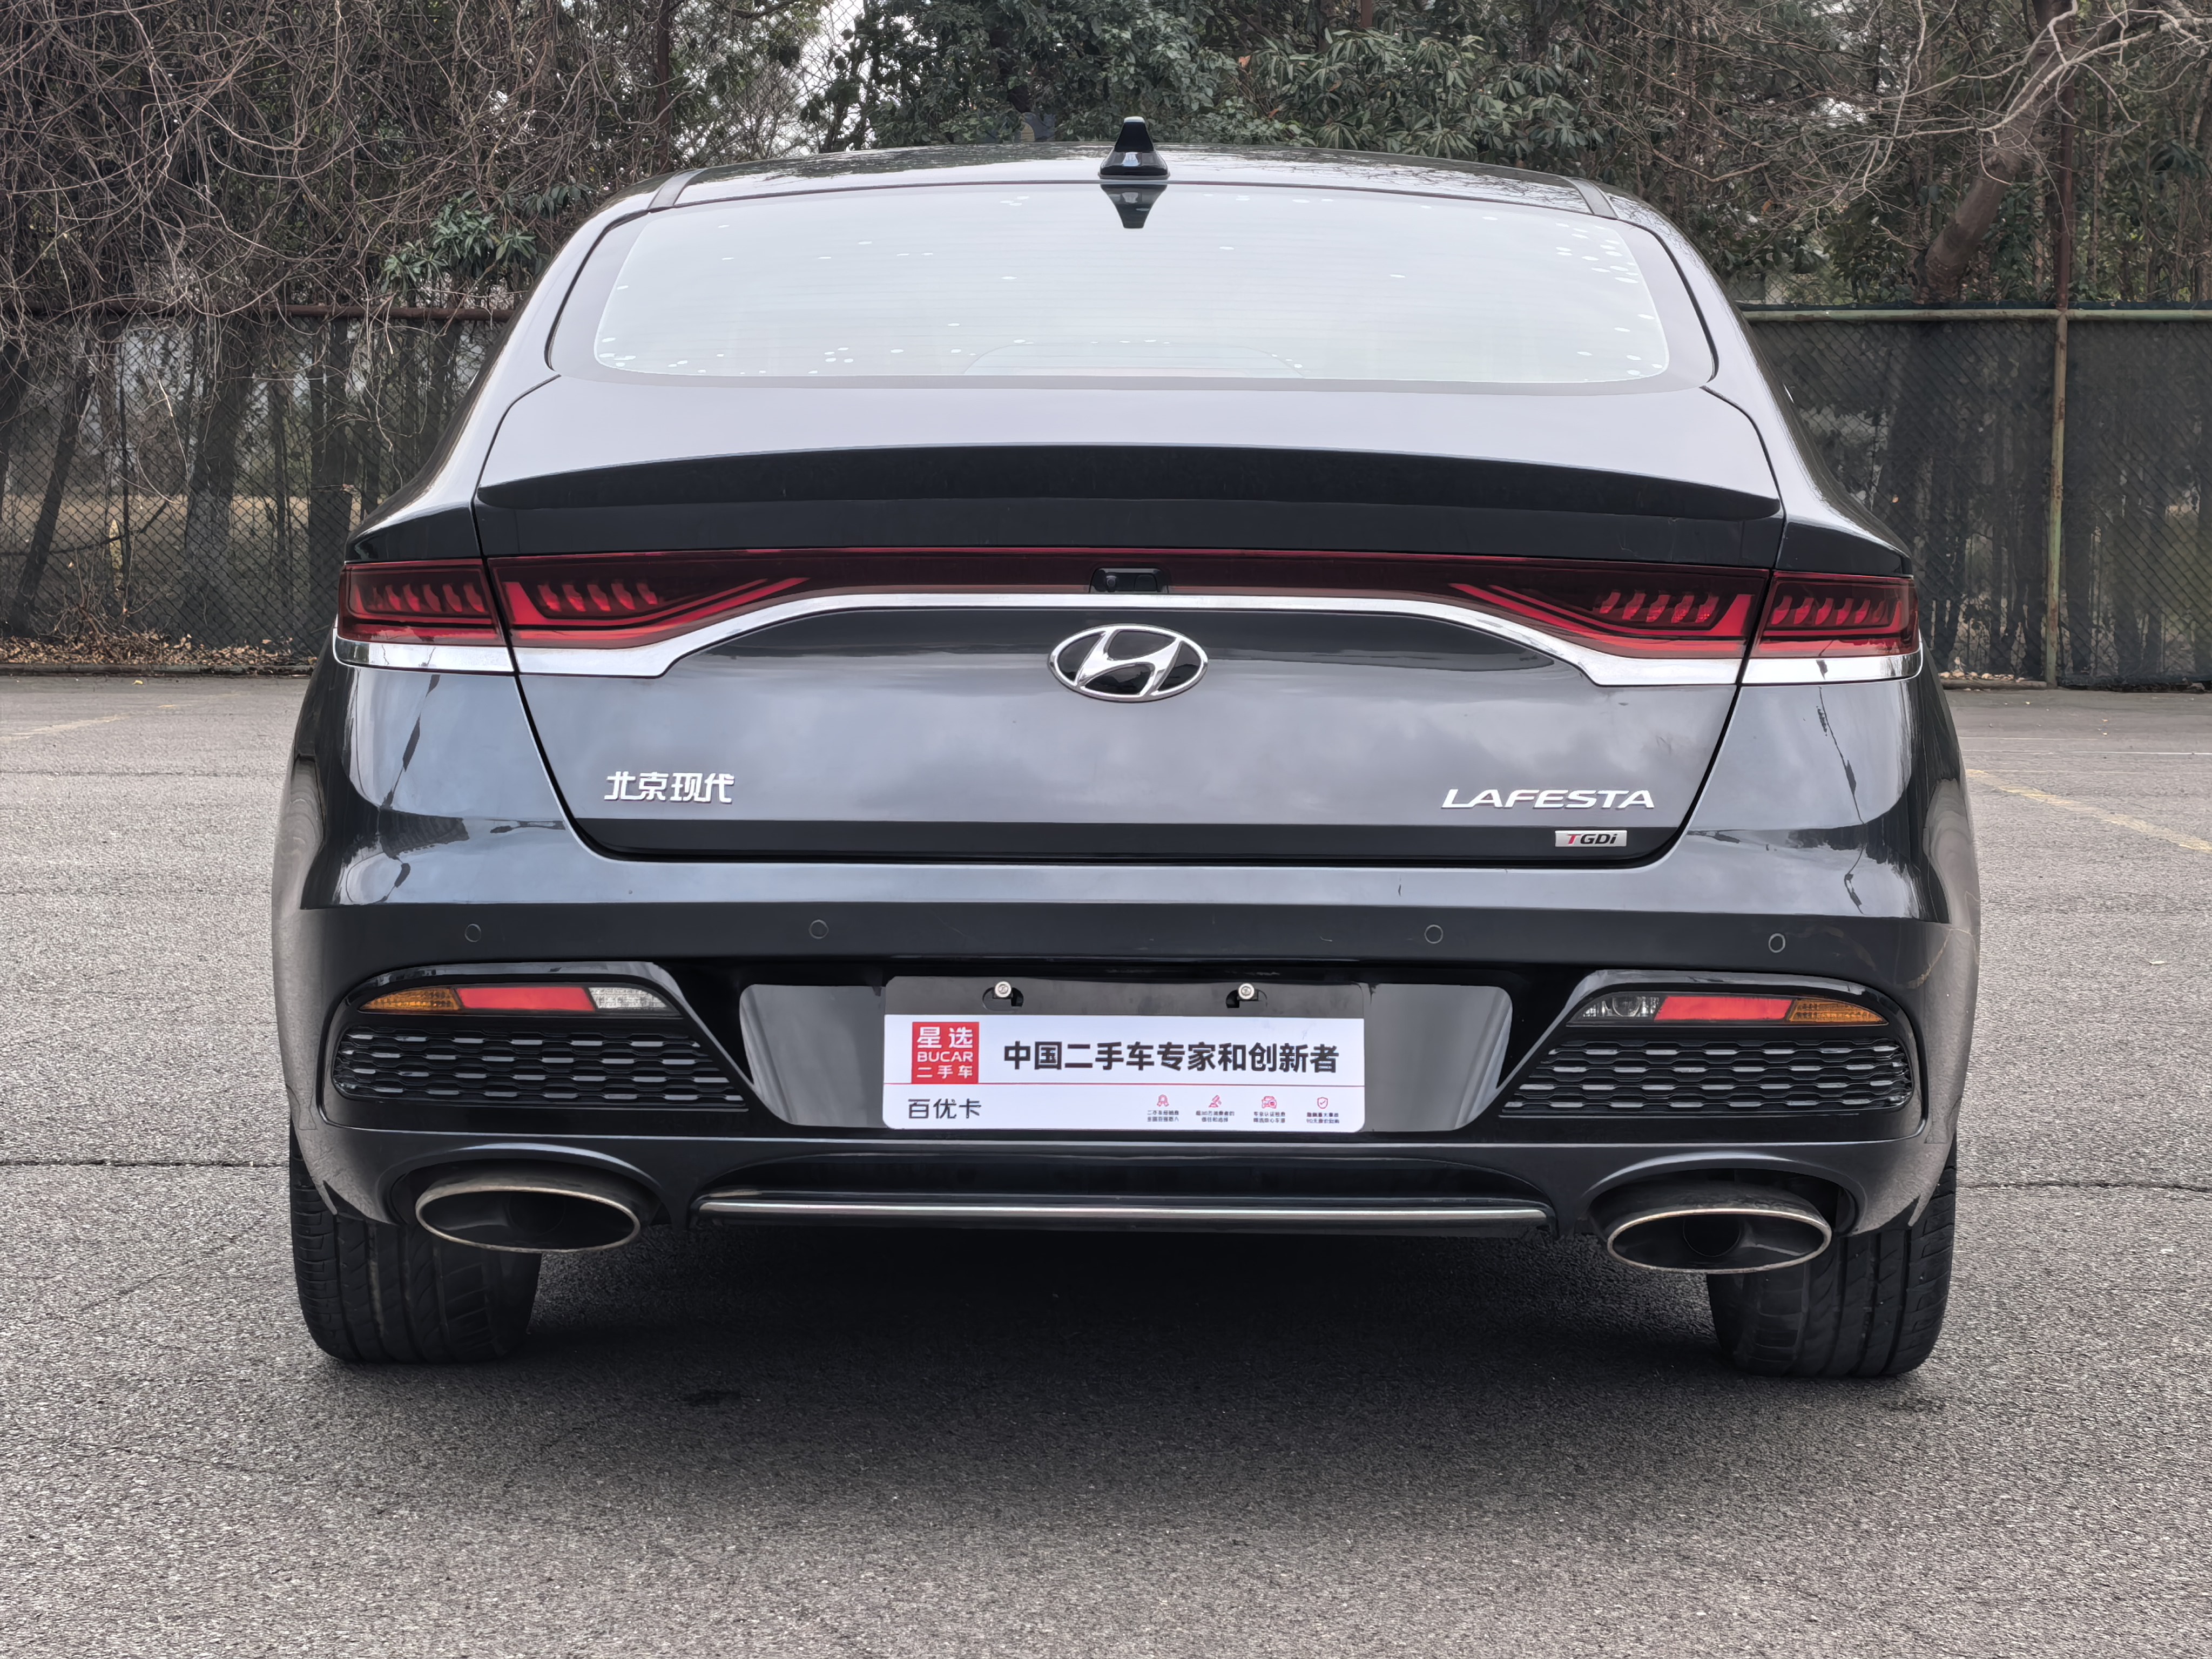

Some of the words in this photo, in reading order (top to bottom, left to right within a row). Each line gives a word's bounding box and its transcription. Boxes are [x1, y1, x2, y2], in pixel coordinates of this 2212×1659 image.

[604, 771, 734, 803] 北京现代
[1441, 789, 1655, 809] LAFESTA
[1566, 833, 1618, 845] TGDi
[917, 1026, 973, 1048] 星选
[917, 1051, 973, 1062] BUCAR
[1004, 1040, 1339, 1073] 中国二手车专家和创新者
[916, 1064, 973, 1079] 二手车
[908, 1098, 982, 1119] 百优卡
